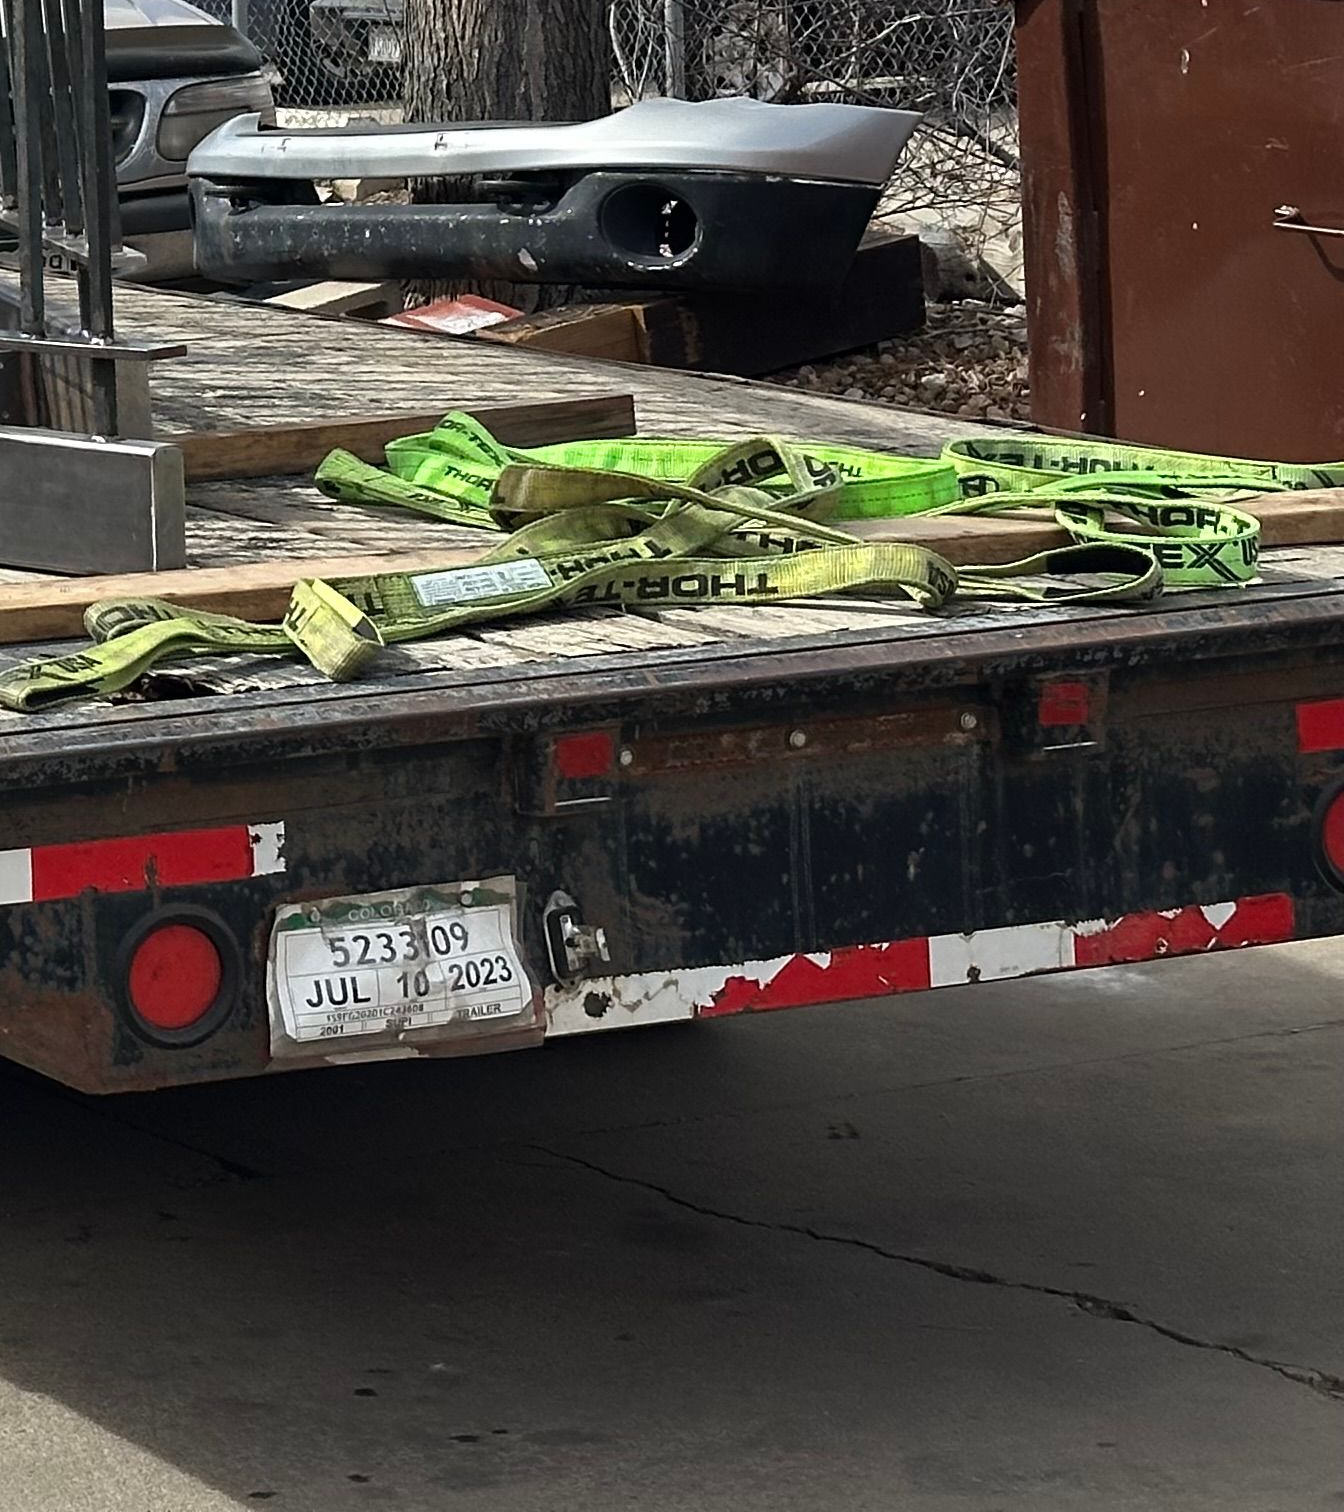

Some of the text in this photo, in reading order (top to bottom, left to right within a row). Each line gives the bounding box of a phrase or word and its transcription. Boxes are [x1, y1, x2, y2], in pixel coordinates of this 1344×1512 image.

[348, 898, 431, 921] COLORO
[306, 955, 512, 1008] JUL 10 2023
[457, 1003, 502, 1019] TRAILER
